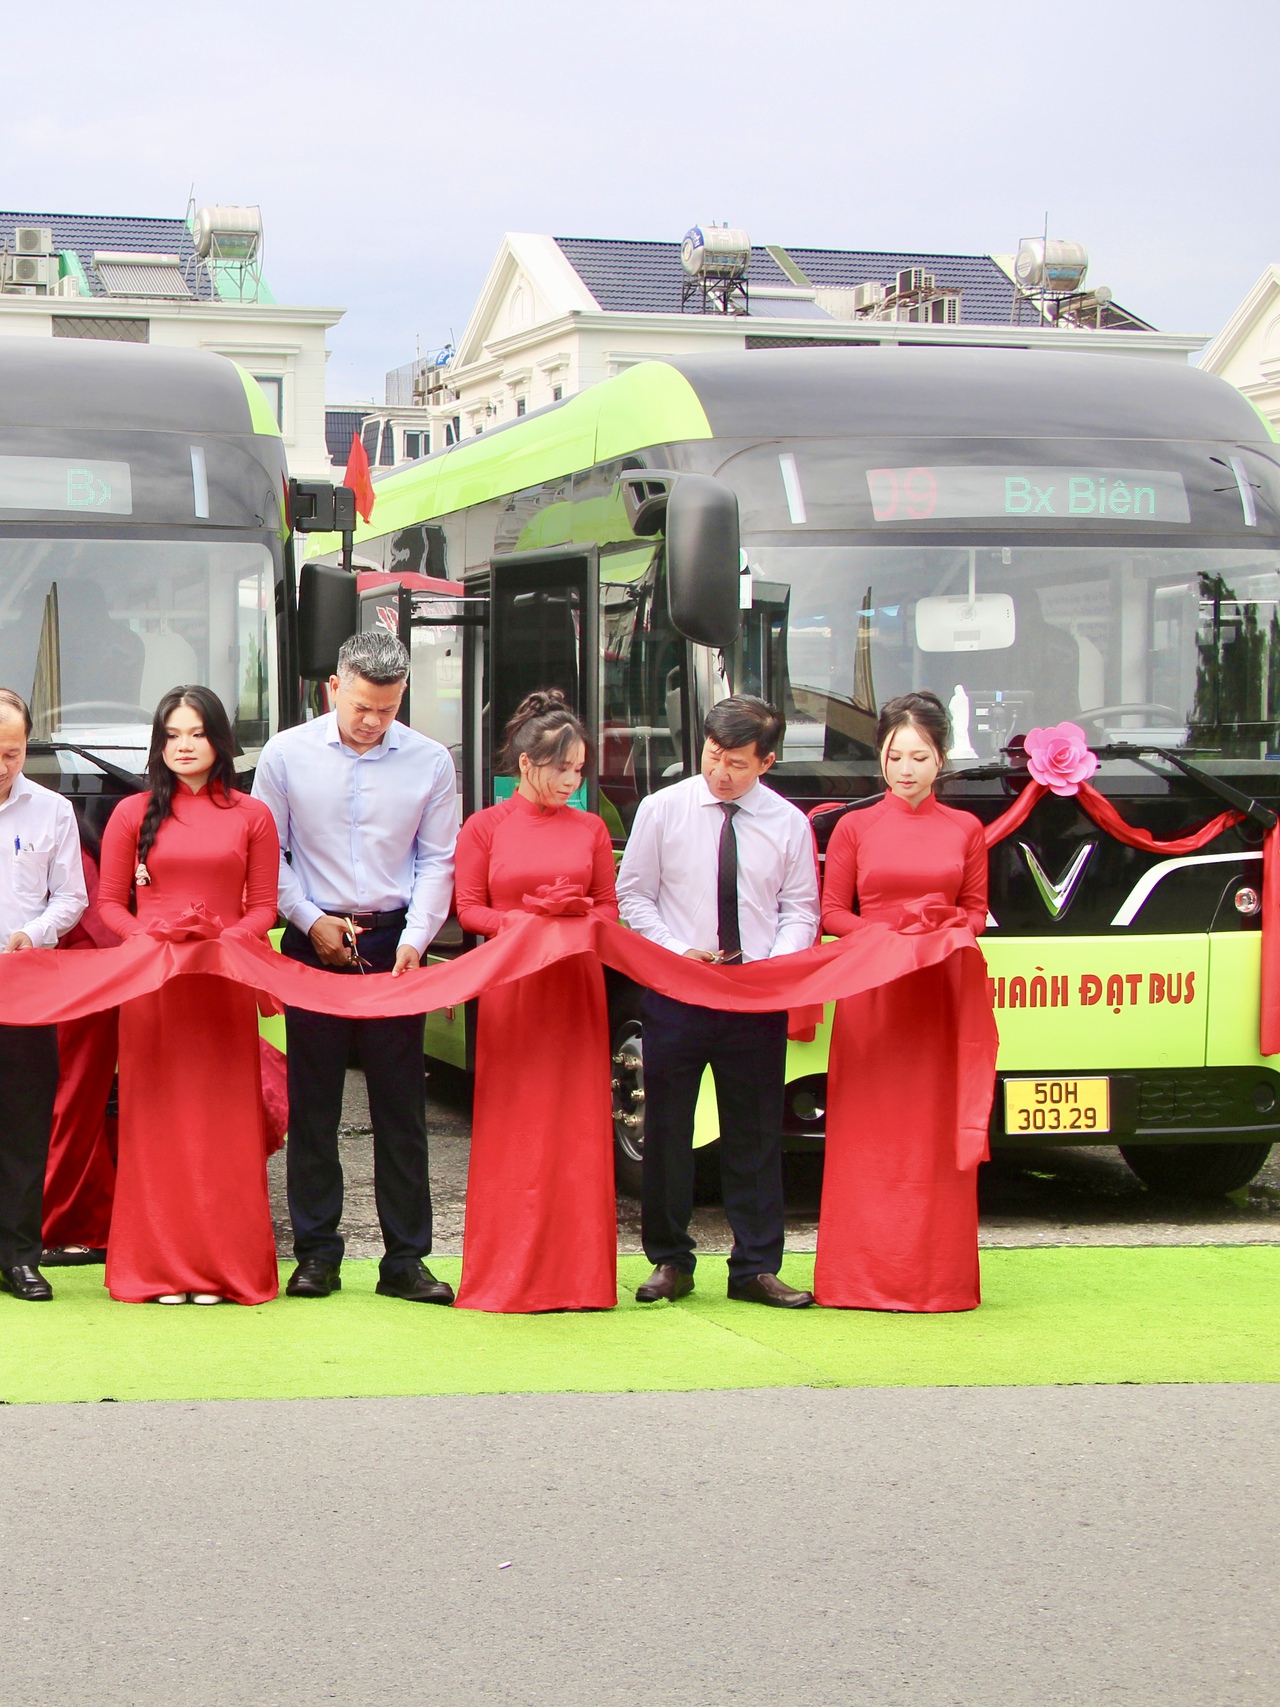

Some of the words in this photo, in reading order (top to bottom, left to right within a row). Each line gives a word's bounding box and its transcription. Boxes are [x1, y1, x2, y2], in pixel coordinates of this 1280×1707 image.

[868, 467, 938, 519] 09
[1004, 476, 1056, 514] Bx
[1069, 479, 1155, 515] Biên
[986, 966, 1068, 1008] HÀNH
[1079, 974, 1142, 1015] ĐẠT
[1149, 971, 1195, 1005] BUS
[1034, 1082, 1078, 1104] 50H
[1017, 1107, 1097, 1130] 303.29
